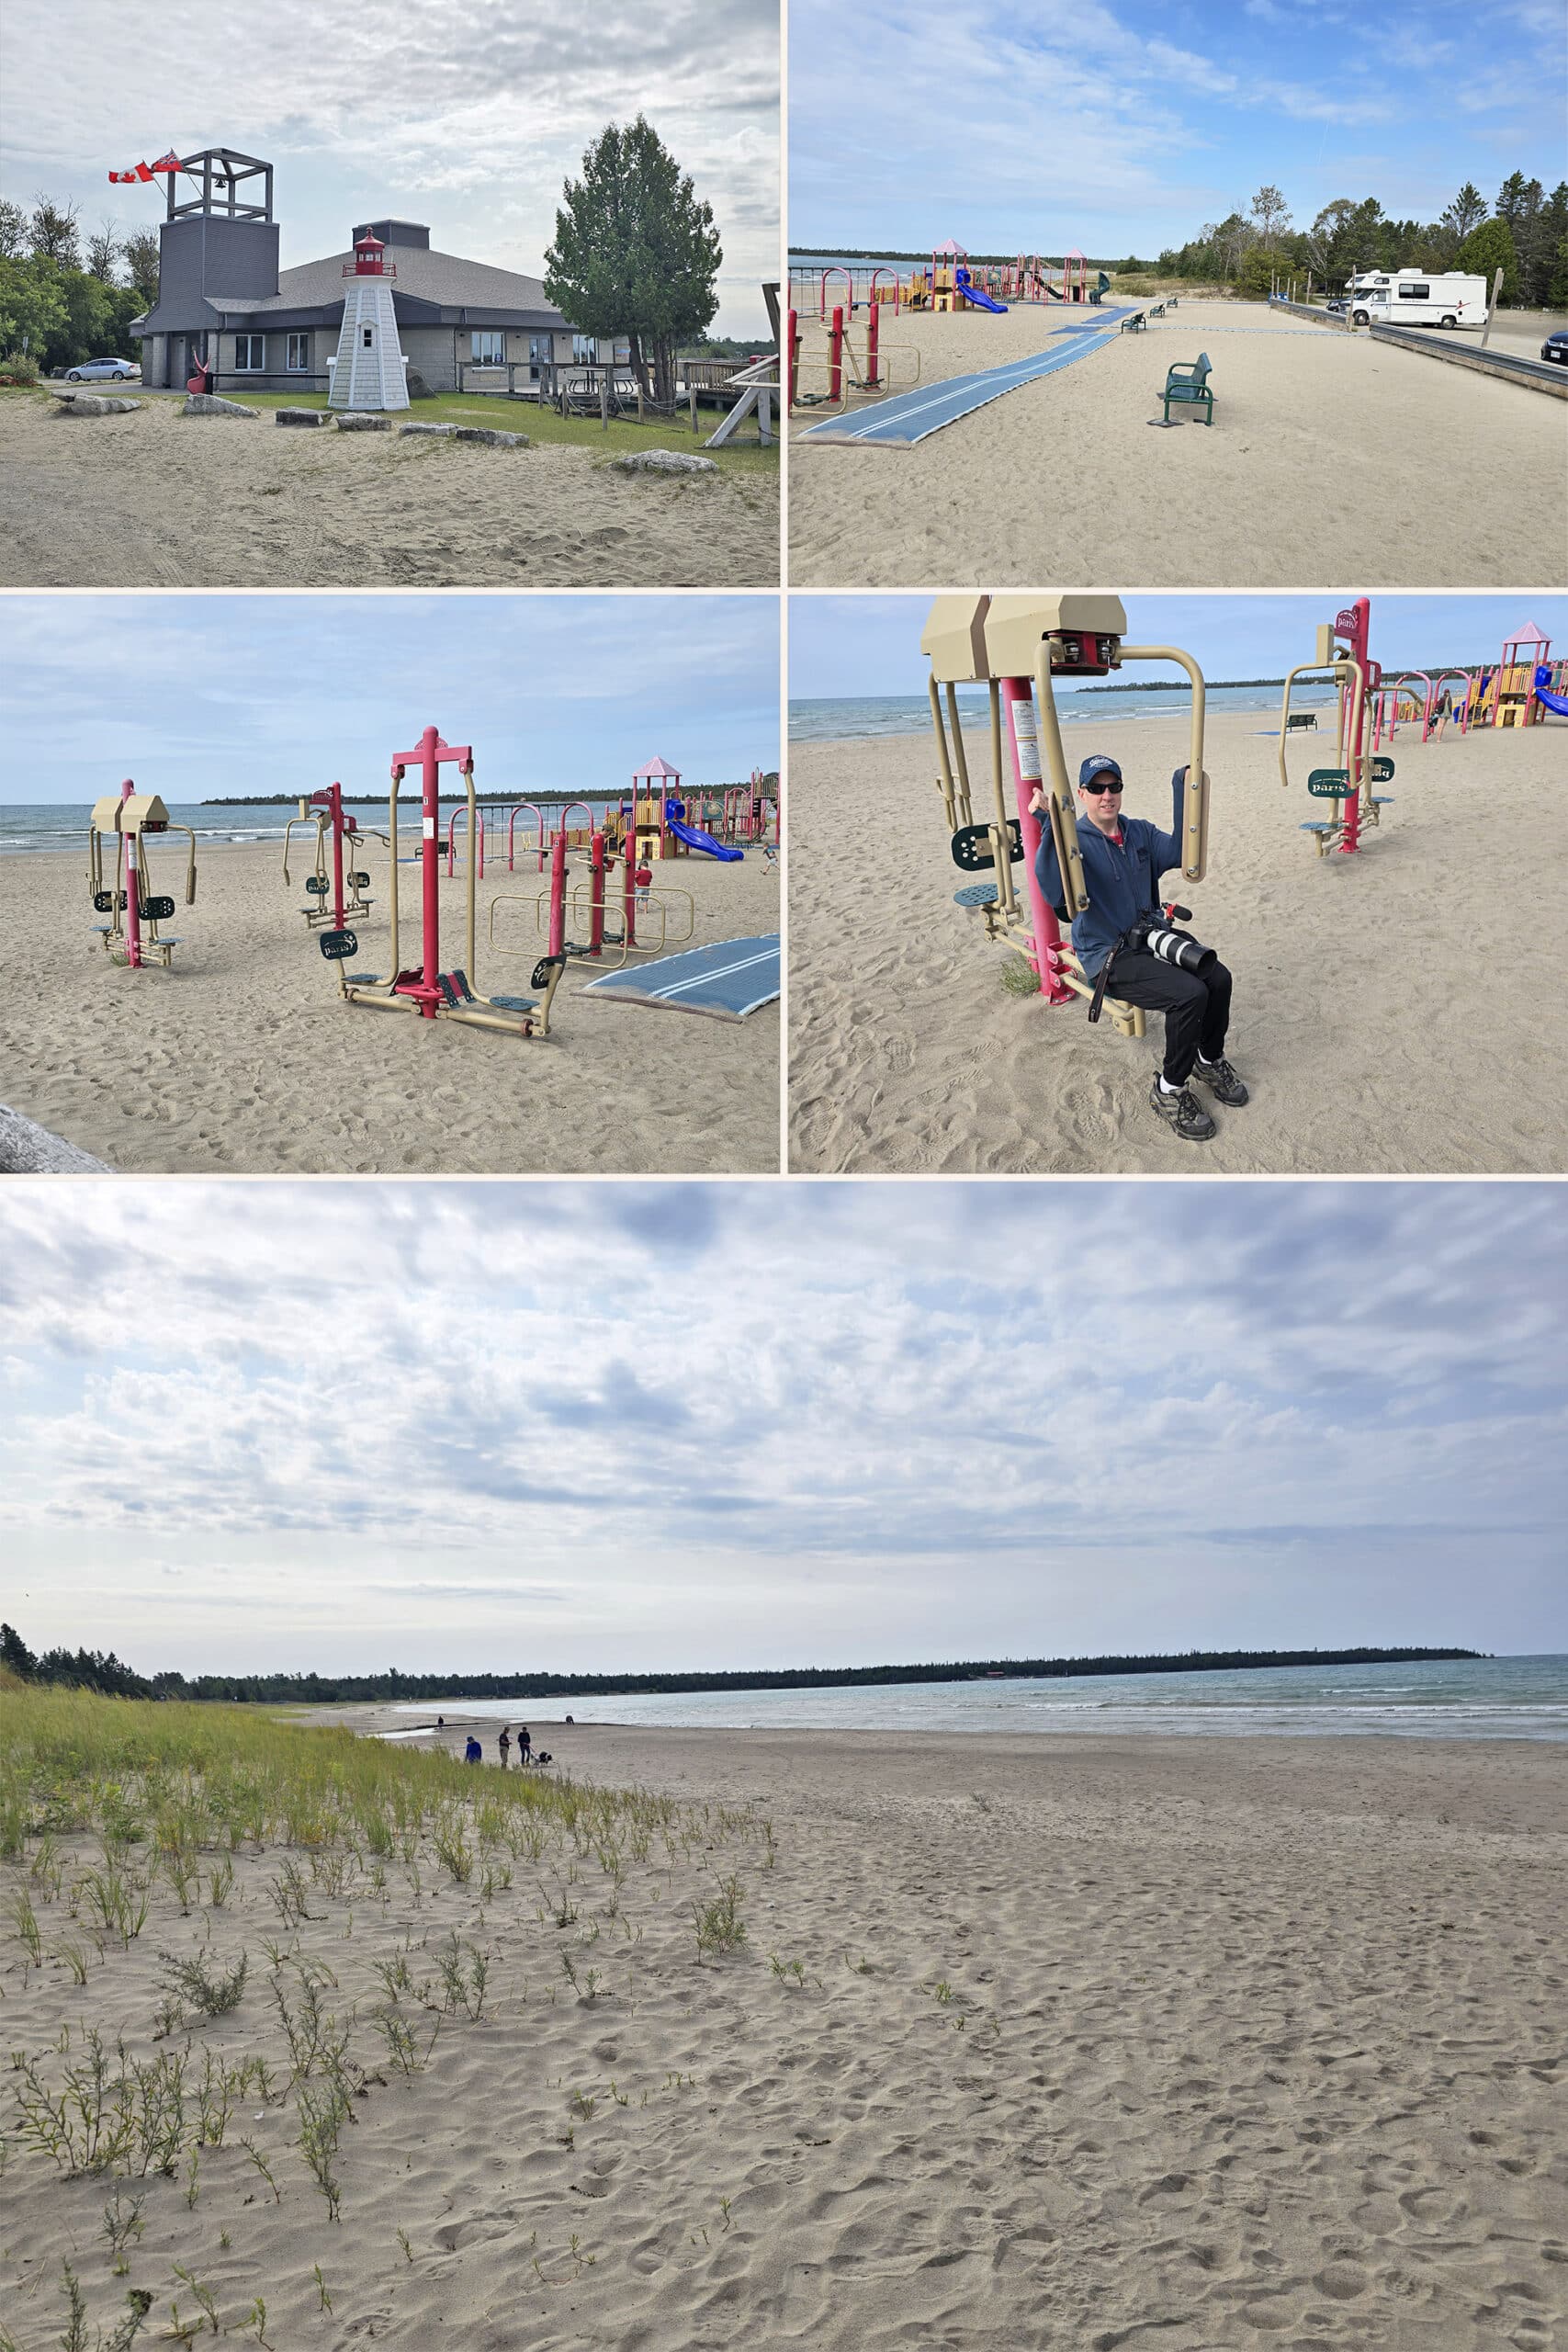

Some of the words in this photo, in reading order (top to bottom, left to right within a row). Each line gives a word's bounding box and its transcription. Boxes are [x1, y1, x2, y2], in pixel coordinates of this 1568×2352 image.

[1337, 617, 1354, 628] paris
[1312, 782, 1345, 792] paris
[324, 944, 349, 956] paris
